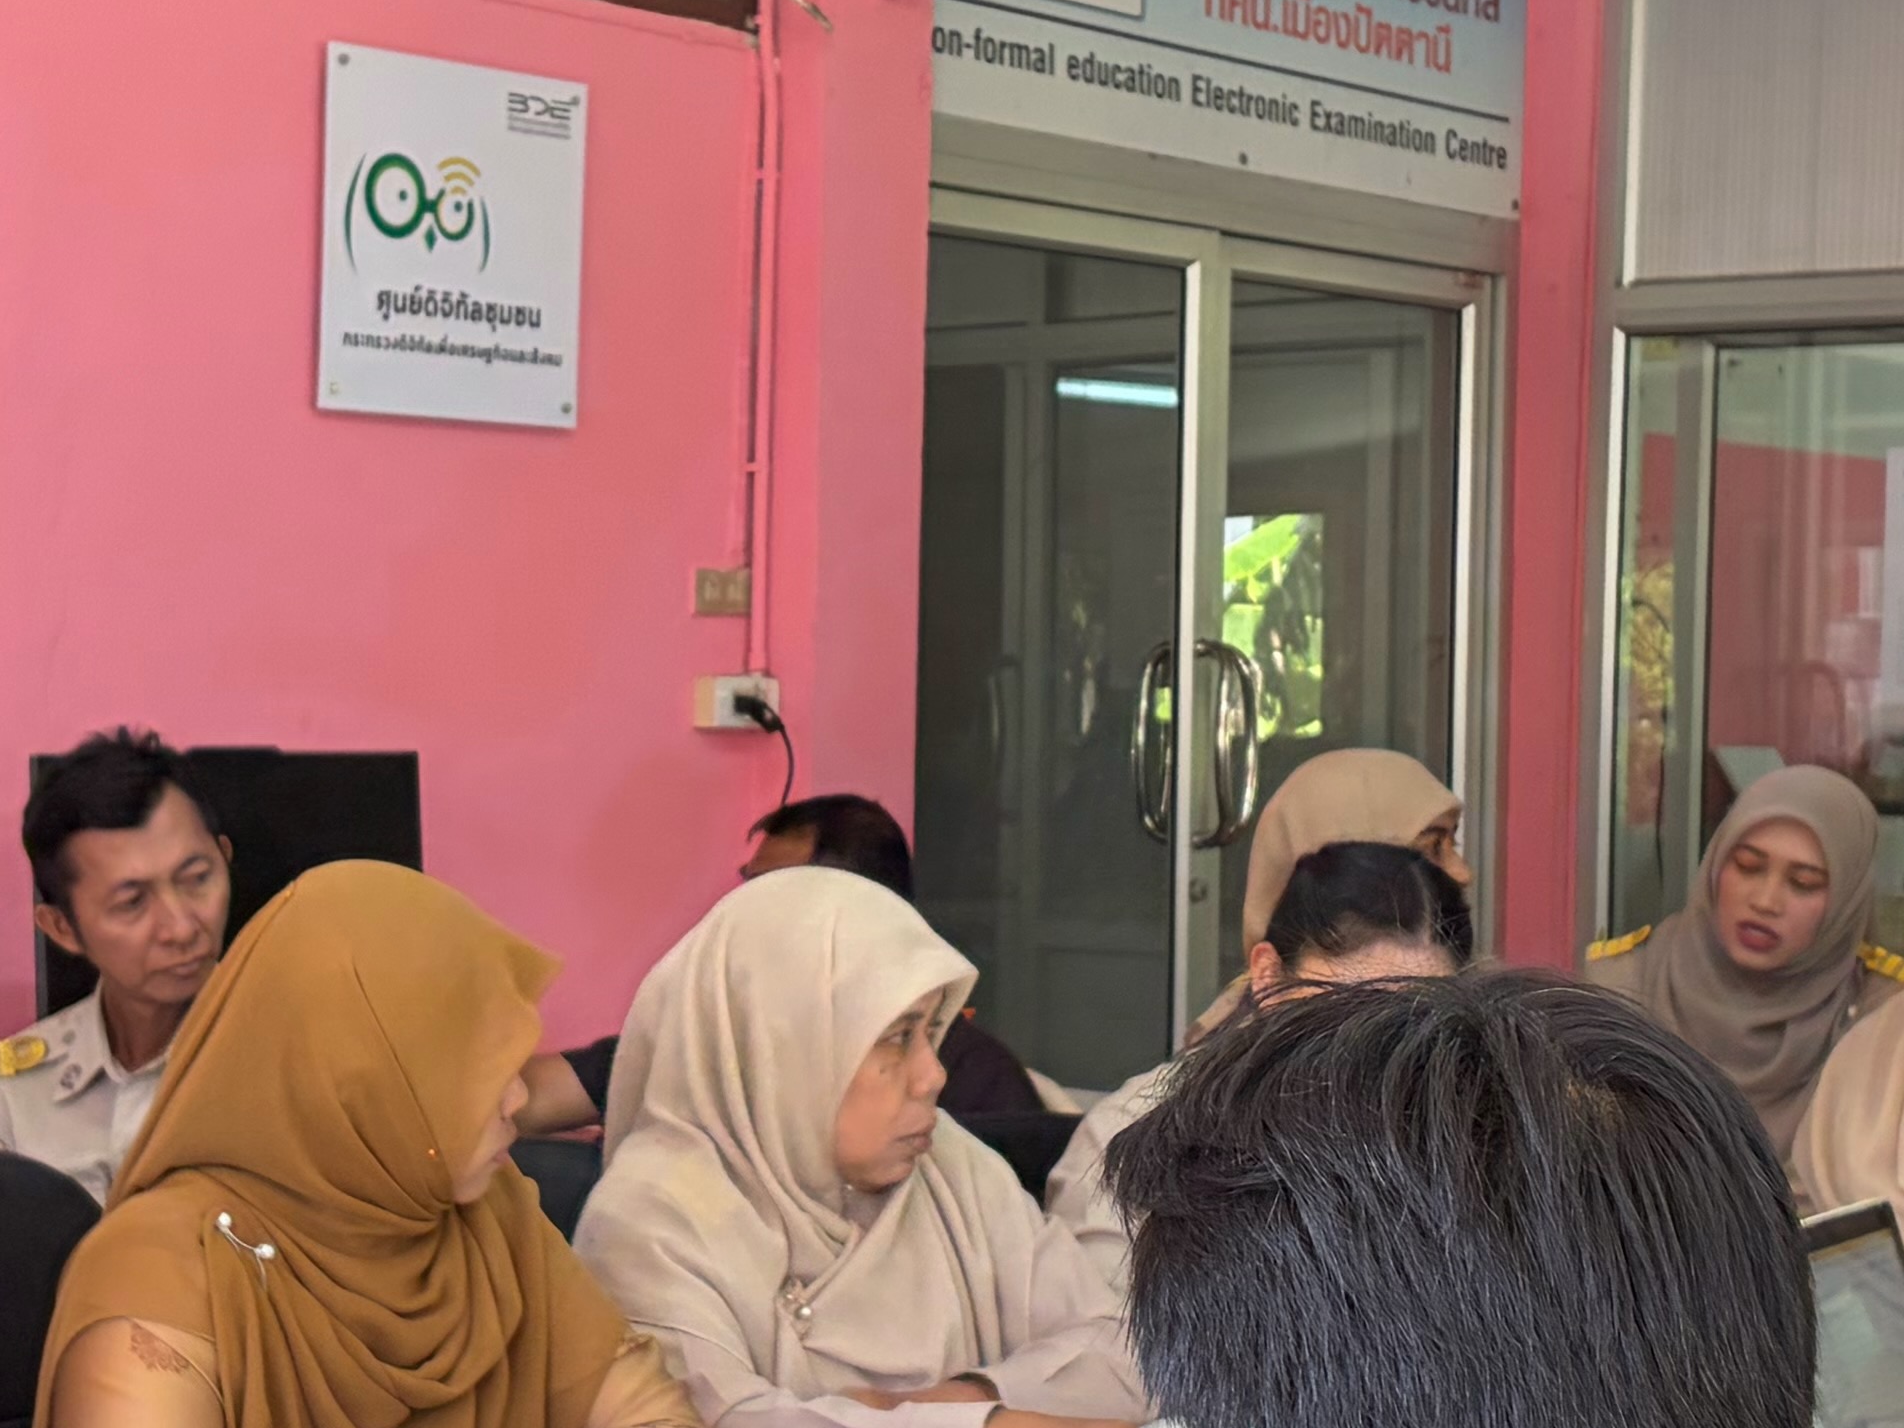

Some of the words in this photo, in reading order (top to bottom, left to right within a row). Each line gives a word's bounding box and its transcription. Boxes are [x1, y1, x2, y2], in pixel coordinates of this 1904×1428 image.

[931, 25, 1055, 76] on-formal
[1066, 51, 1182, 102] education
[1190, 74, 1301, 127] Electronic
[1309, 99, 1437, 156] Examination
[1444, 128, 1508, 170] Centre
[376, 285, 542, 333] ศูนย์ดิจิทัลชุมชน
